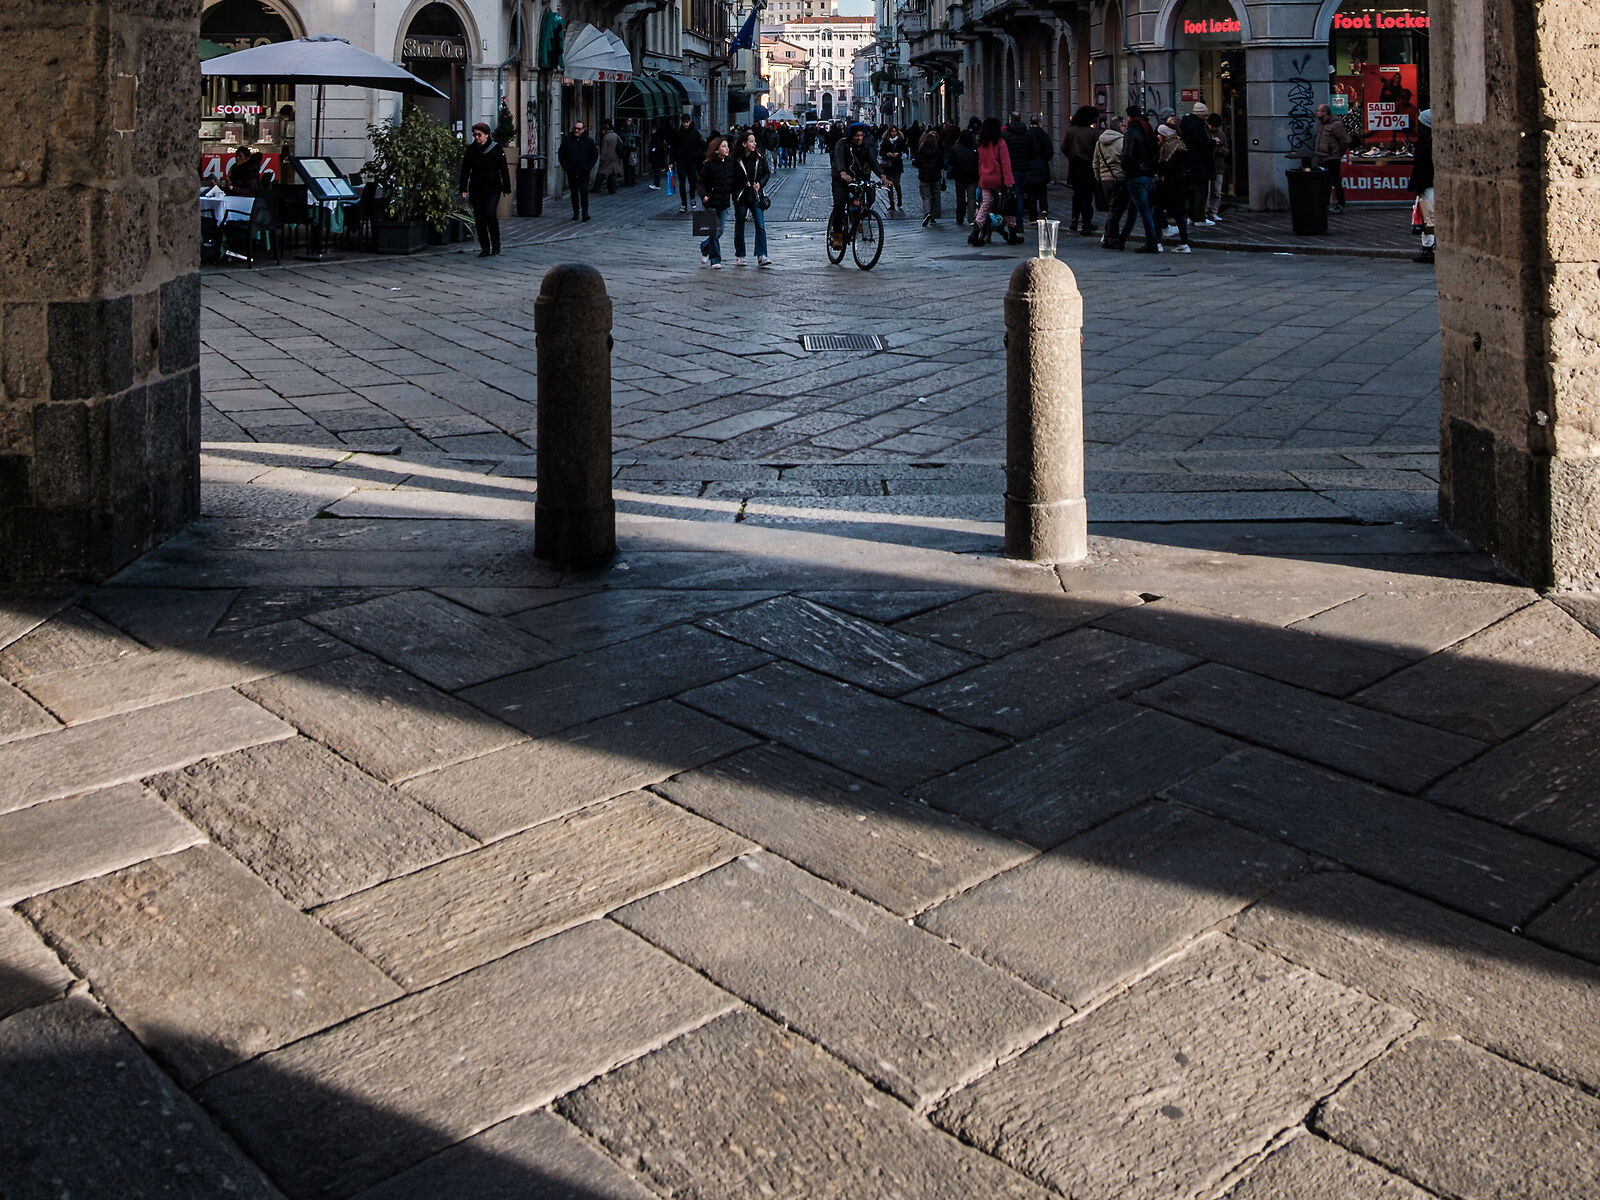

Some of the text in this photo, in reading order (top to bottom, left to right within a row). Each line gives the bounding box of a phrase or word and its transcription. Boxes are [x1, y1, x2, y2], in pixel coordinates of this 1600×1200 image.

[1184, 17, 1240, 34] Foot Locke
[1334, 13, 1371, 29] Foot
[217, 104, 261, 114] SCONTI
[1368, 103, 1394, 112] SALDI
[1341, 176, 1411, 189] ALDI SALD
